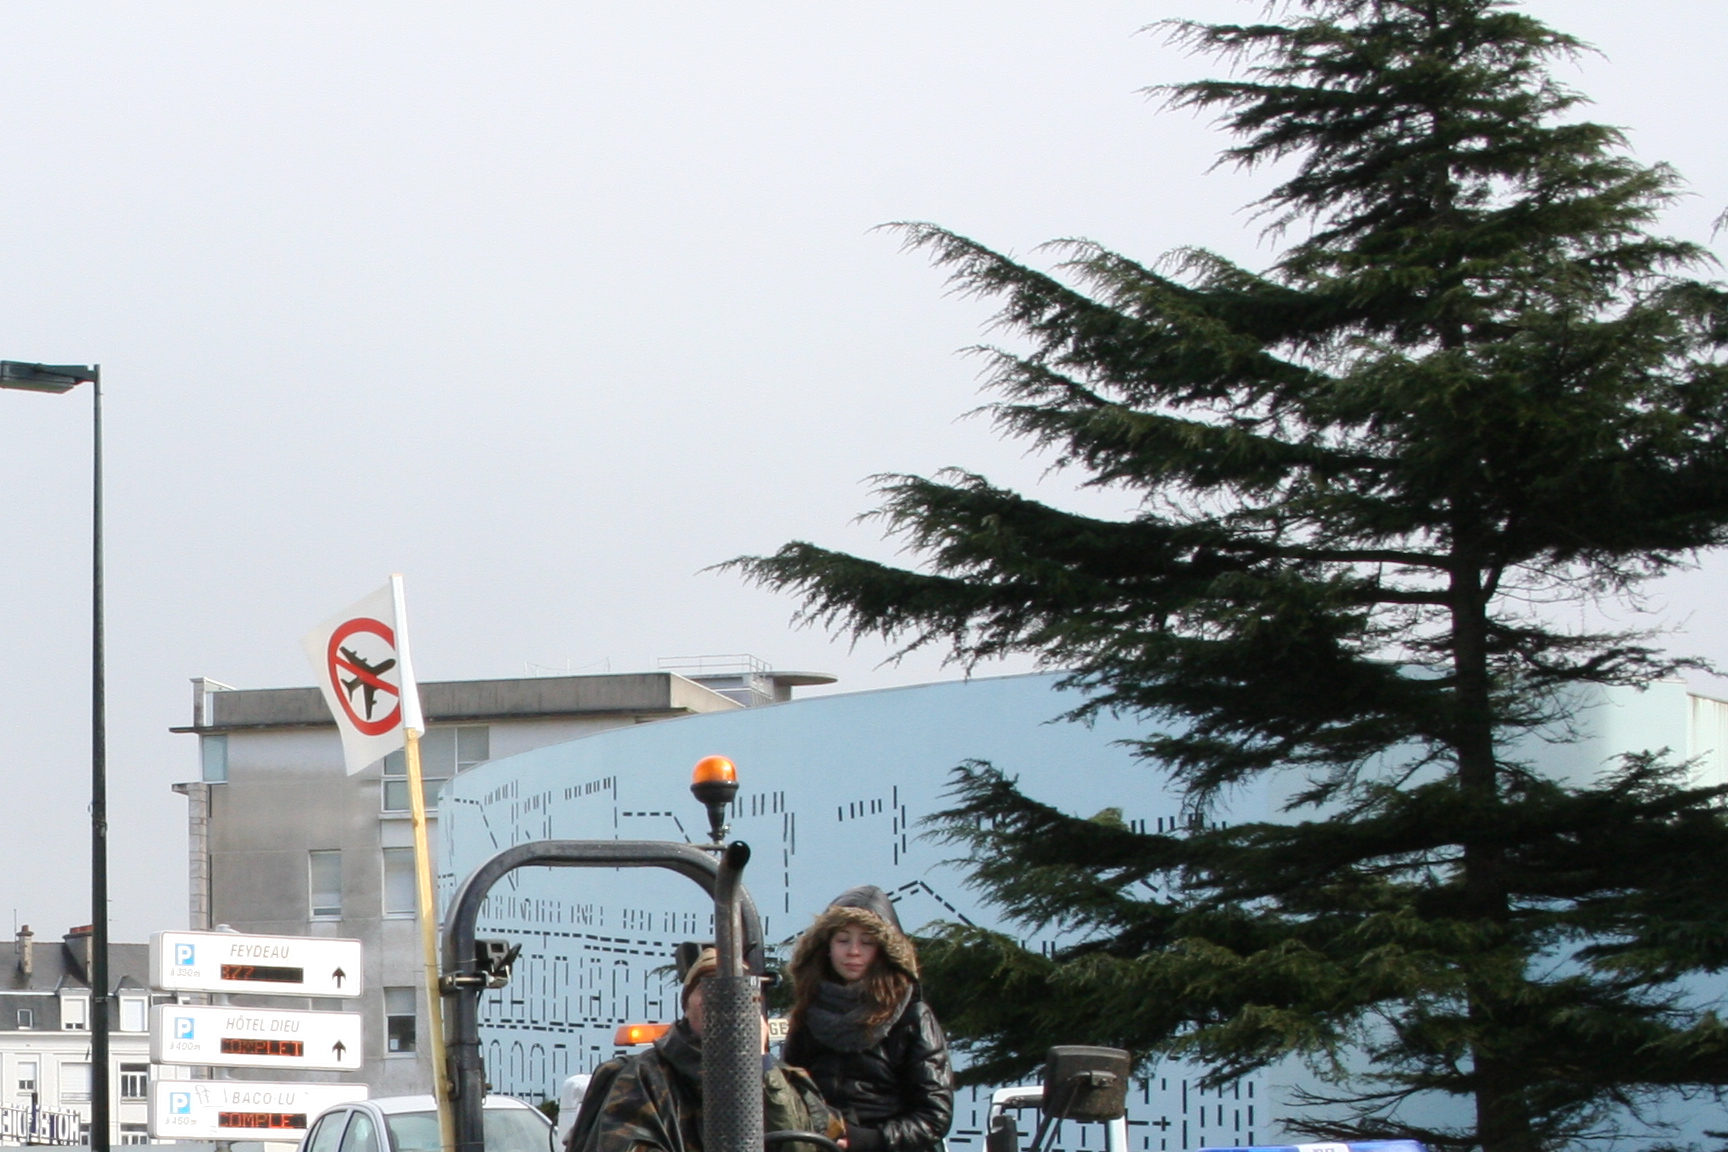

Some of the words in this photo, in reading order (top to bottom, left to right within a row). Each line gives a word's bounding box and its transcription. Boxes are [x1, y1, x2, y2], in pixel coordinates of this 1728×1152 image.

[176, 944, 194, 965] P
[229, 943, 290, 959] FEYDEAU
[175, 1018, 194, 1038] P
[226, 1015, 266, 1031] HÔTEL
[270, 1018, 300, 1032] DIEU
[171, 1092, 190, 1113] P
